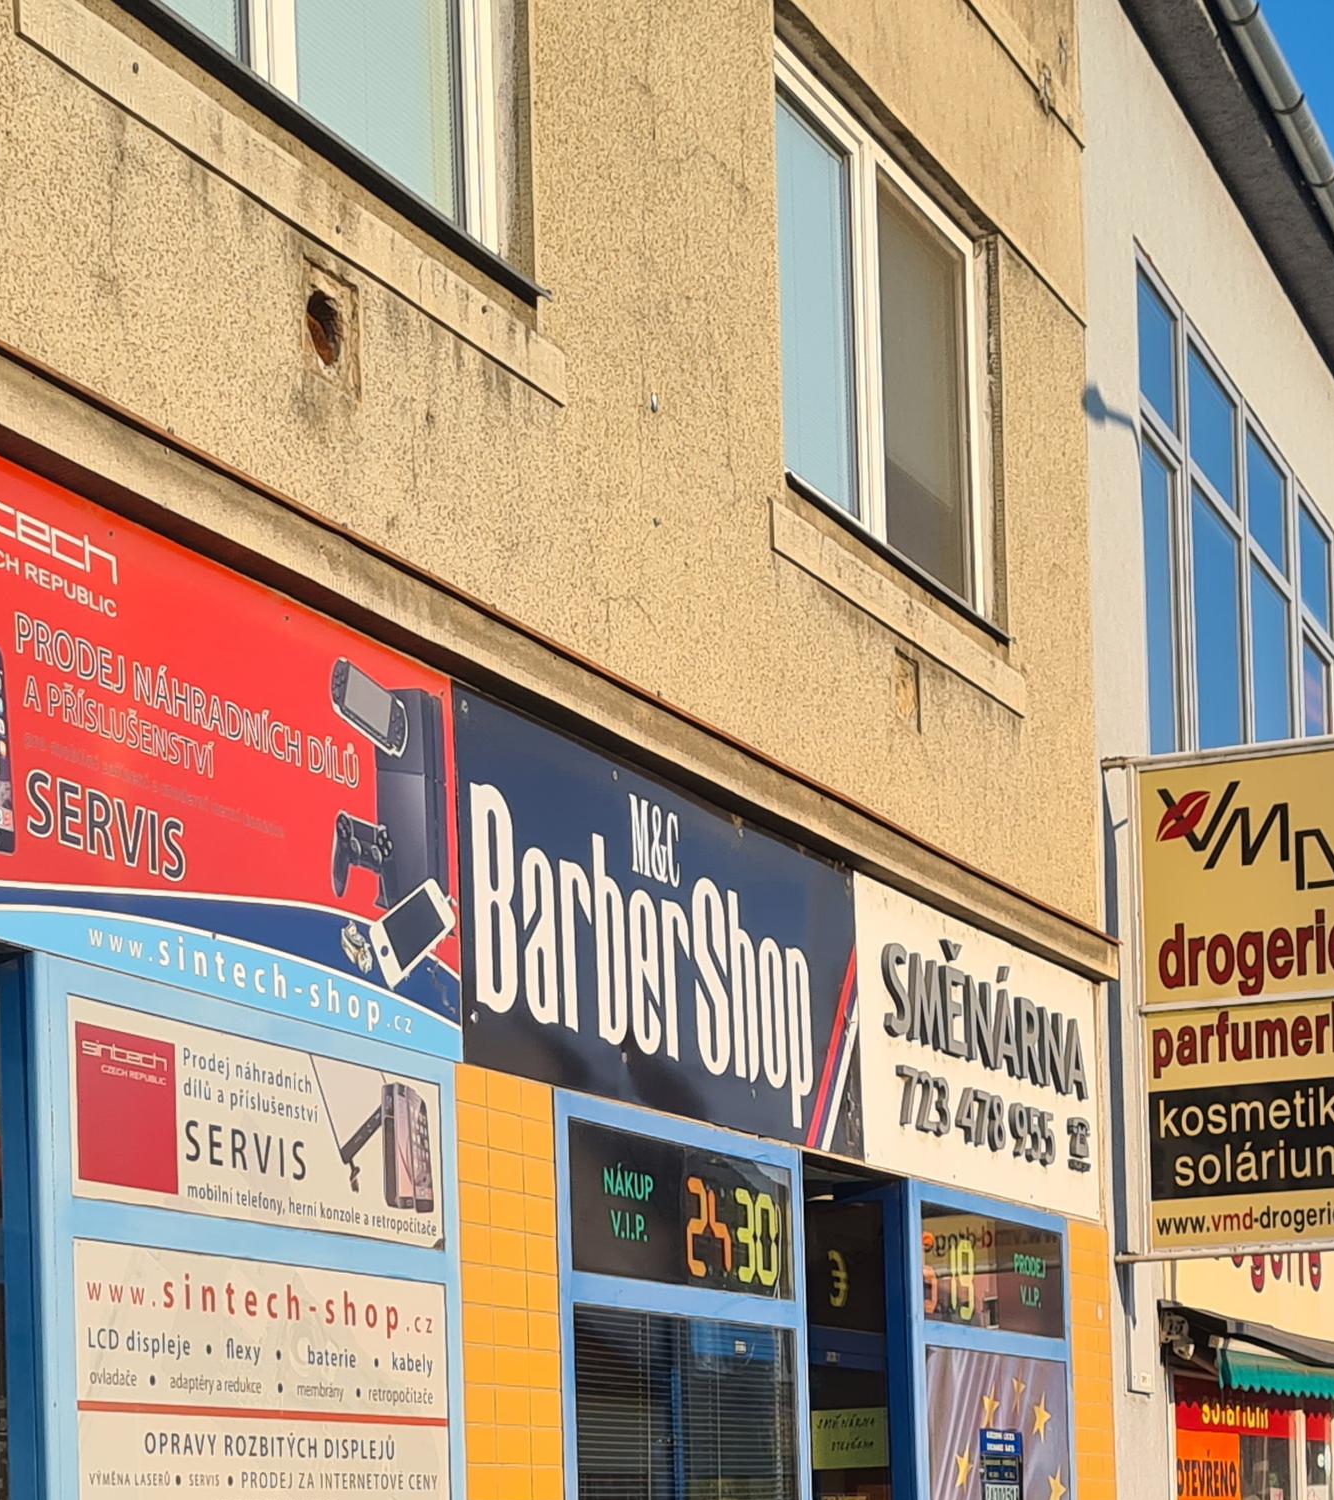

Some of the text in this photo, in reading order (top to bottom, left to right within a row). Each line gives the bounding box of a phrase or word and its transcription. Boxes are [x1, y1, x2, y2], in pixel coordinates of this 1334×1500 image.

[25, 561, 119, 618] REPUBLIC
[14, 610, 127, 698] PRODEJ
[133, 664, 303, 768] NÁHRADNÍCH
[308, 738, 362, 790] DÍLŮ
[23, 676, 216, 780] A PŘÍSLUŠENSTVÍ
[25, 769, 188, 884] SERVIS
[628, 792, 682, 888] M&C
[88, 927, 414, 1035] www.sintech-shop.cz
[470, 782, 817, 1129] BarberShop
[881, 938, 1089, 1101] SMĚNÁRNA
[101, 1063, 167, 1087] CZECH REPUBLIC
[182, 1046, 313, 1095] Prodej náhradních
[182, 1076, 320, 1124] dílů a příslušenství
[896, 1064, 1057, 1167] 723 478 955
[185, 1119, 308, 1181] SERVIS
[602, 1161, 655, 1202] NÁKUP
[187, 1182, 437, 1238] mobilní telefony, herní konzole retropočítače
[610, 1207, 649, 1243] V.I.P.
[1013, 1253, 1047, 1280] PRODEJ
[87, 1272, 433, 1338] www.sintech-shop.cz
[87, 1326, 433, 1377] LCD displeje flexy baterie kabely
[89, 1369, 434, 1405] ovladače adaptéry redukce membrány retropočítače
[143, 1431, 396, 1461] OPRAVY ROZBITÝCH DISPLEJŮ
[1176, 1449, 1238, 1498] OTEVŘENO
[89, 1469, 438, 1491] VÝMĚNA LASERŮ SERVIS PRODEJ ZA INTERNETOVÉ CENY
